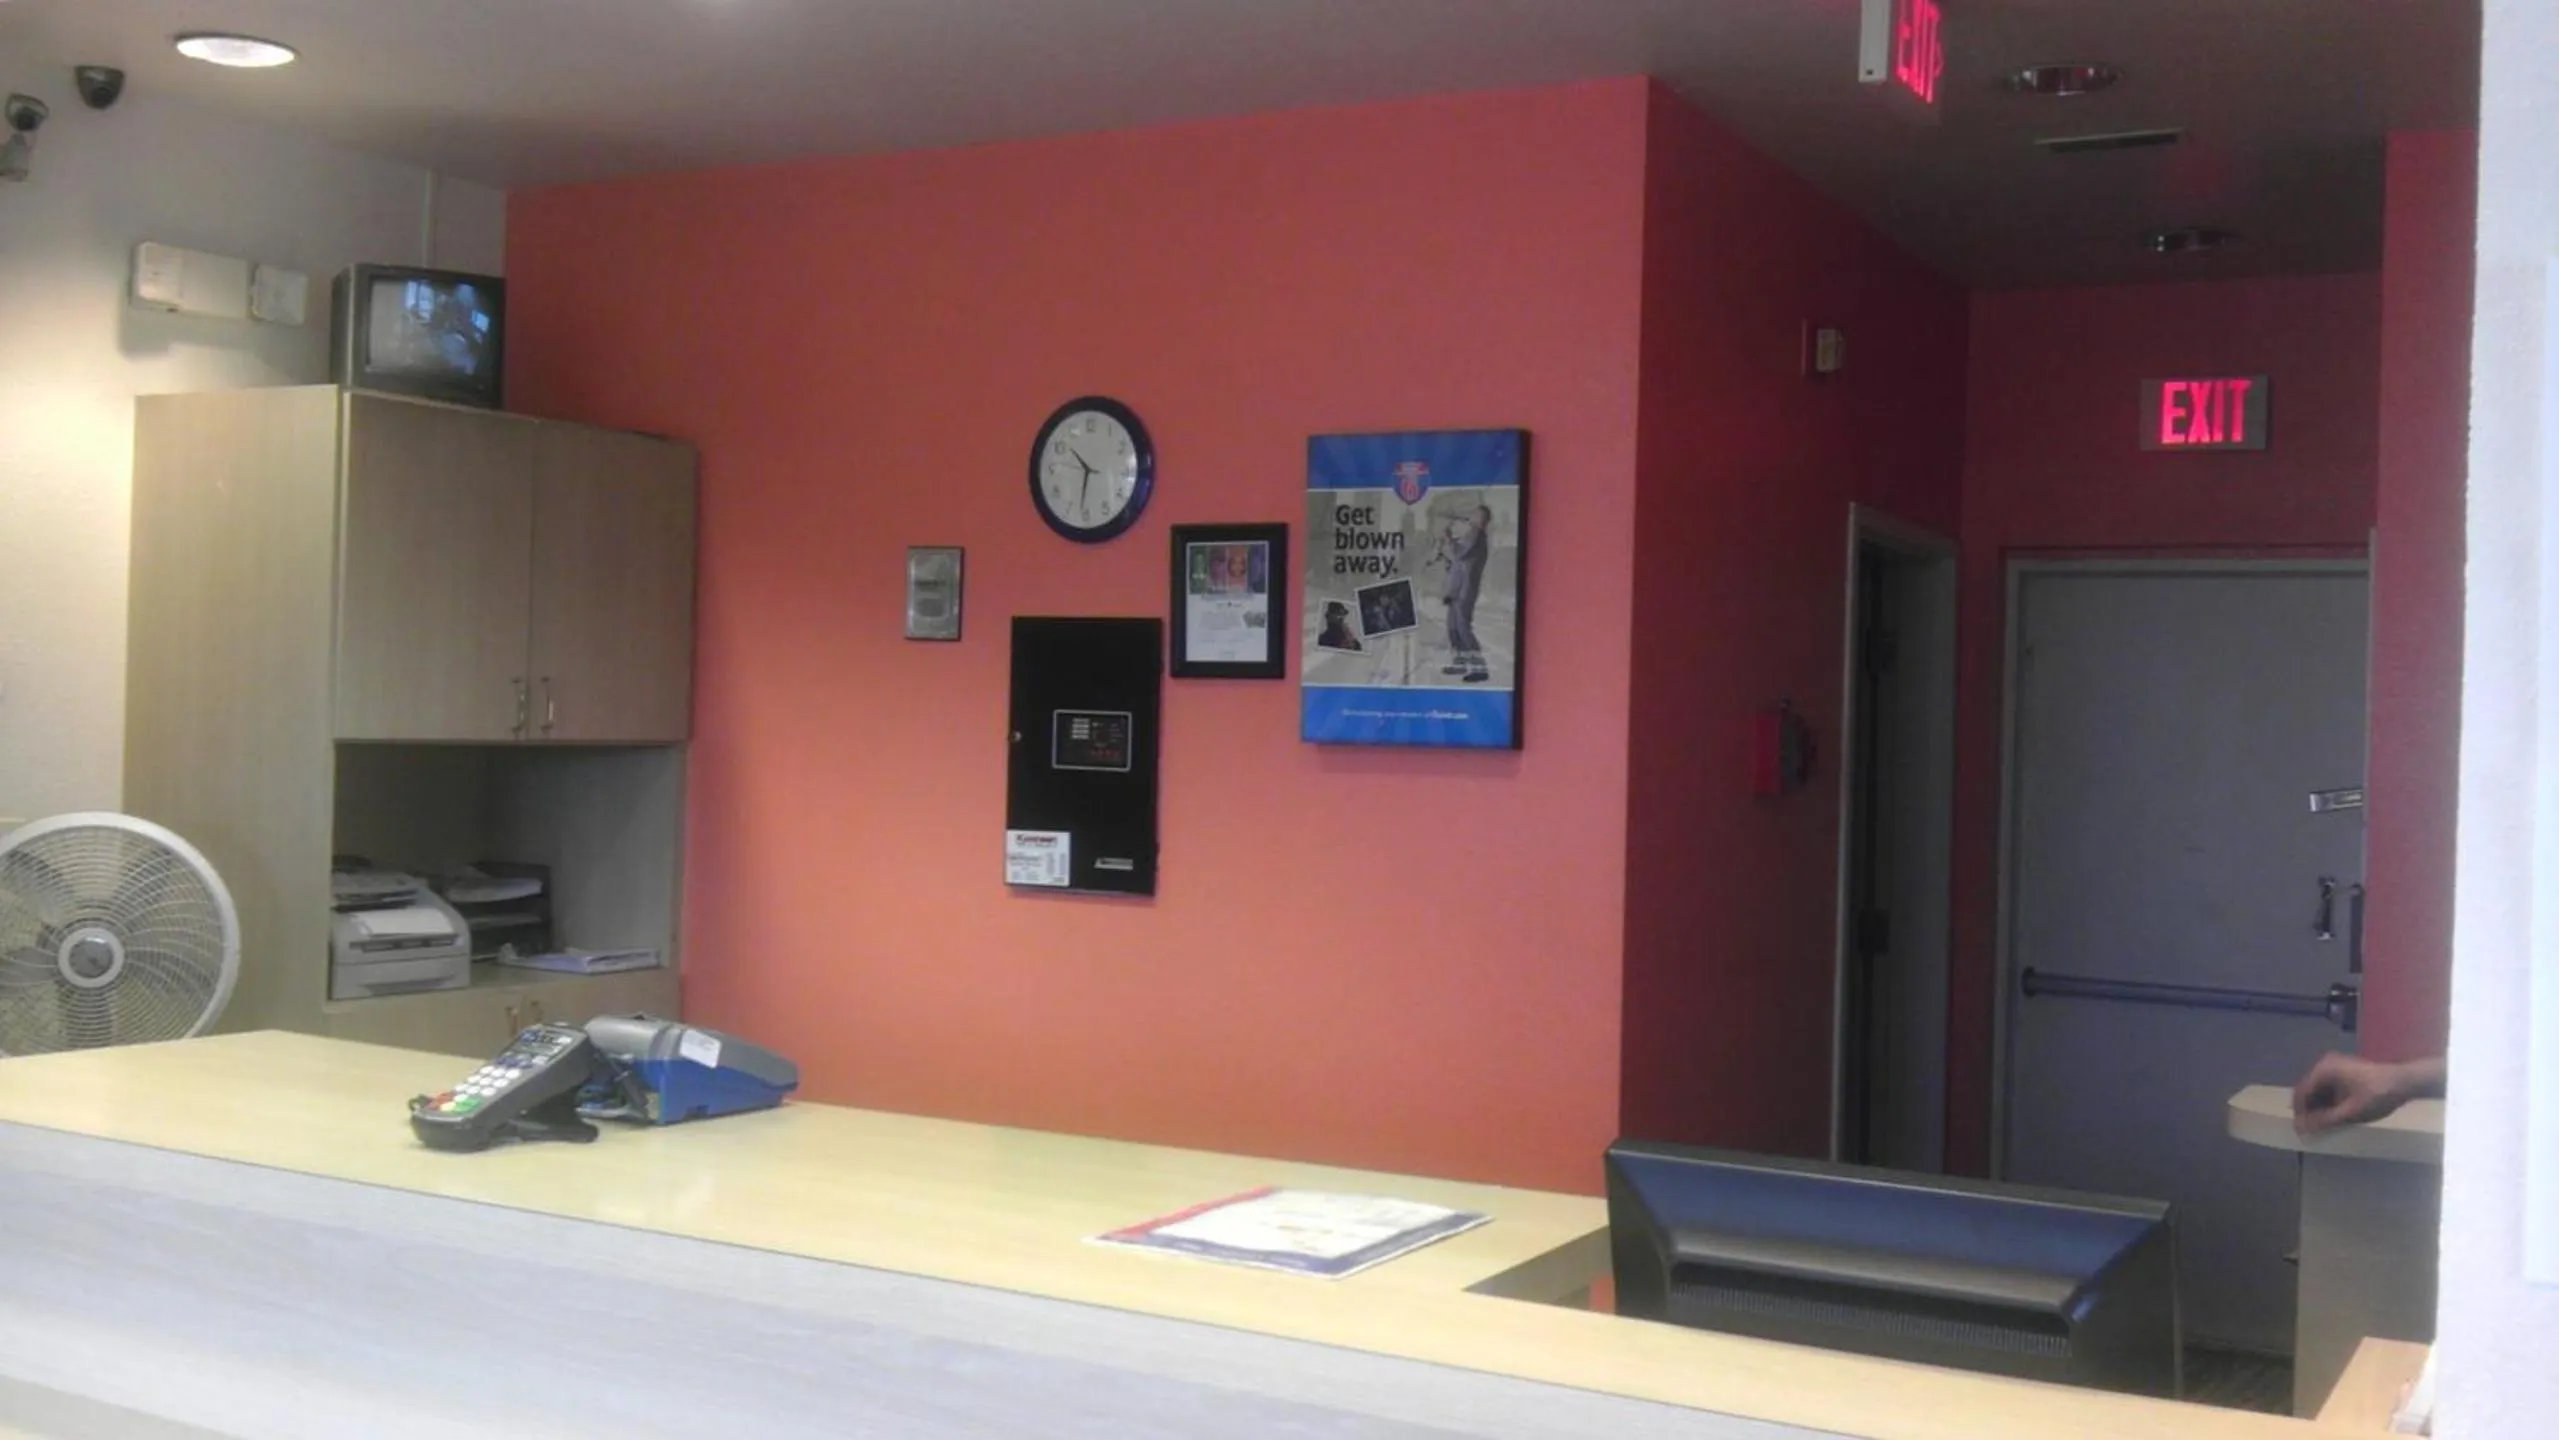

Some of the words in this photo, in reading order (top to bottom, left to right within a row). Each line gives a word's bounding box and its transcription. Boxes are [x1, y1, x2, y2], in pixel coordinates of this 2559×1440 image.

[1896, 0, 1938, 104] EXIT
[2161, 379, 2252, 444] EXIT
[1335, 504, 1375, 526] Get
[1335, 527, 1405, 551] blown
[1333, 555, 1399, 579] away.
